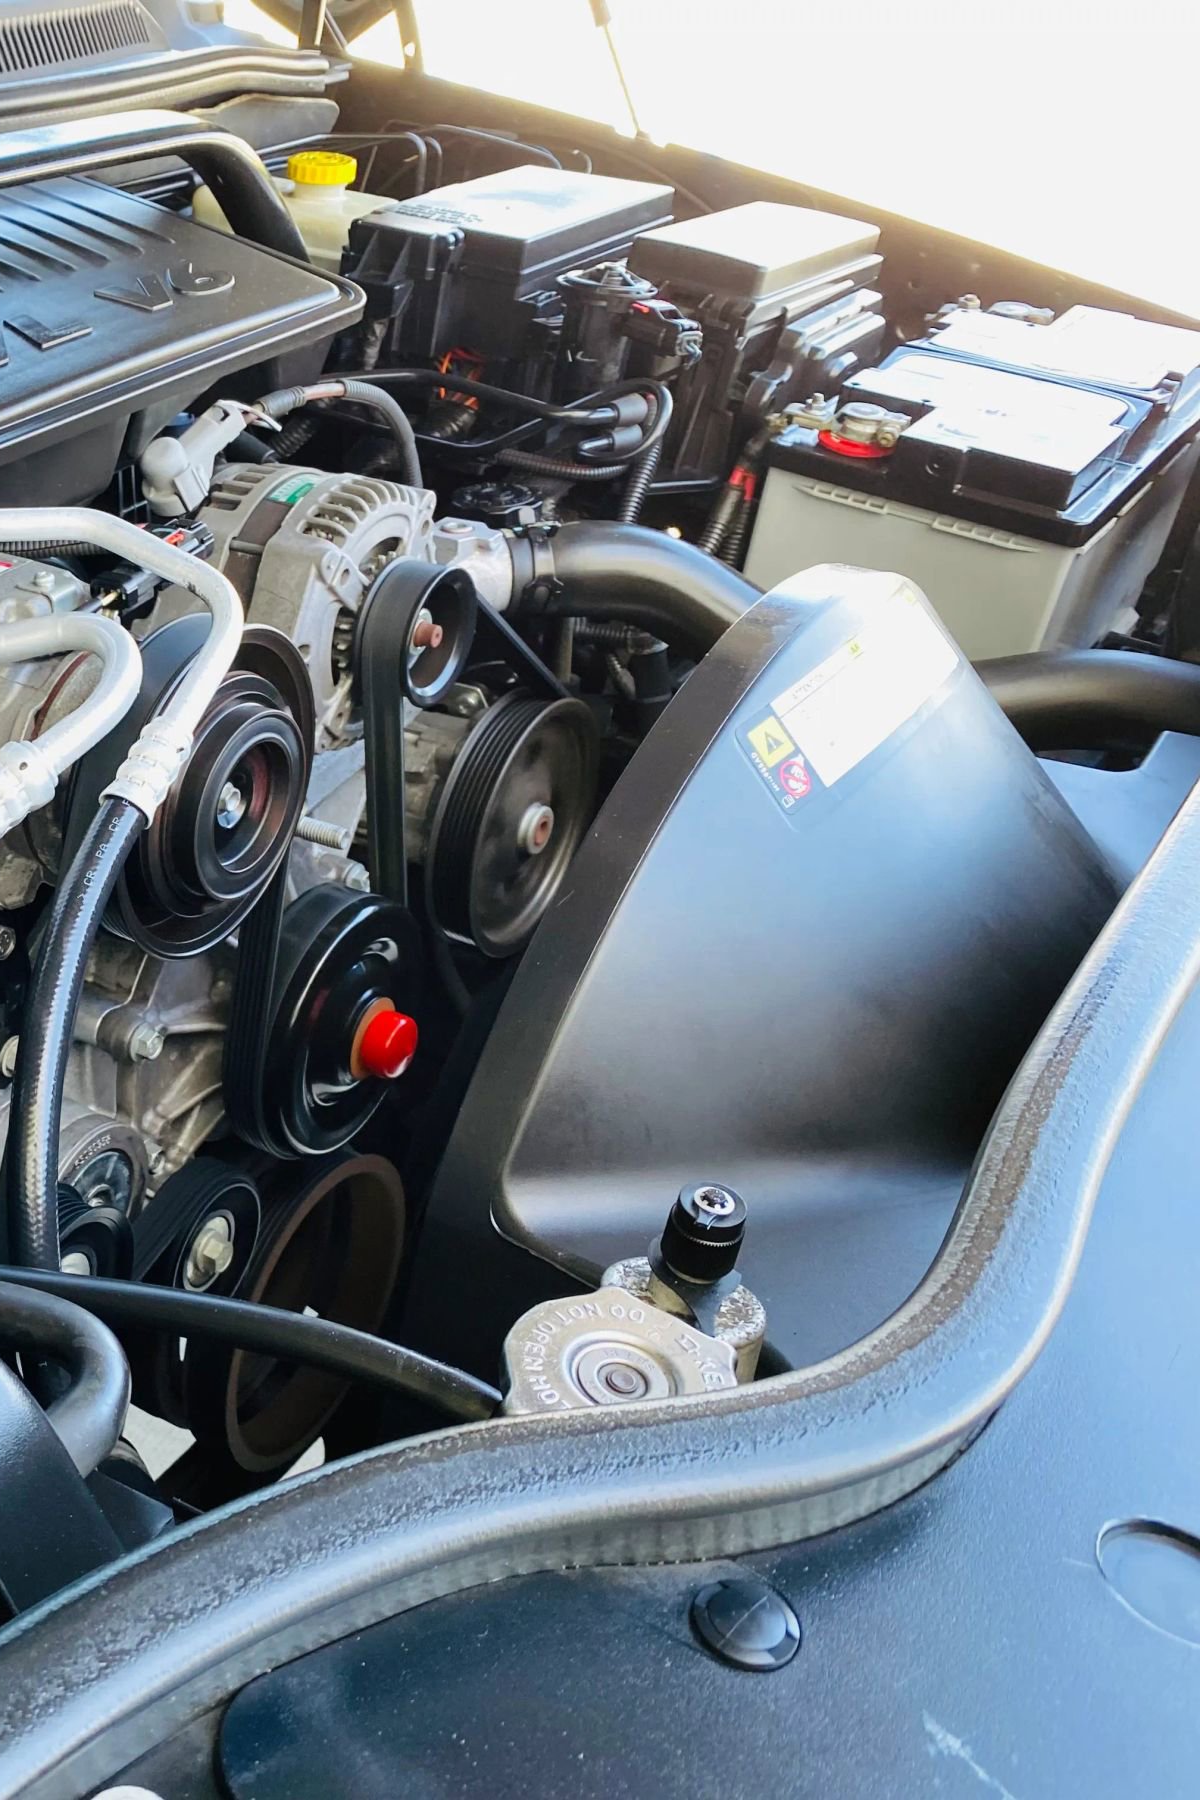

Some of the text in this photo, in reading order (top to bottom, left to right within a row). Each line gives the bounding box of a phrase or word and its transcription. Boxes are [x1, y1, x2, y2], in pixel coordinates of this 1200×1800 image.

[93, 259, 236, 312] V6
[84, 871, 96, 886] CR
[109, 817, 121, 832] CR
[523, 1302, 646, 1410] DO NOT OPEN HO
